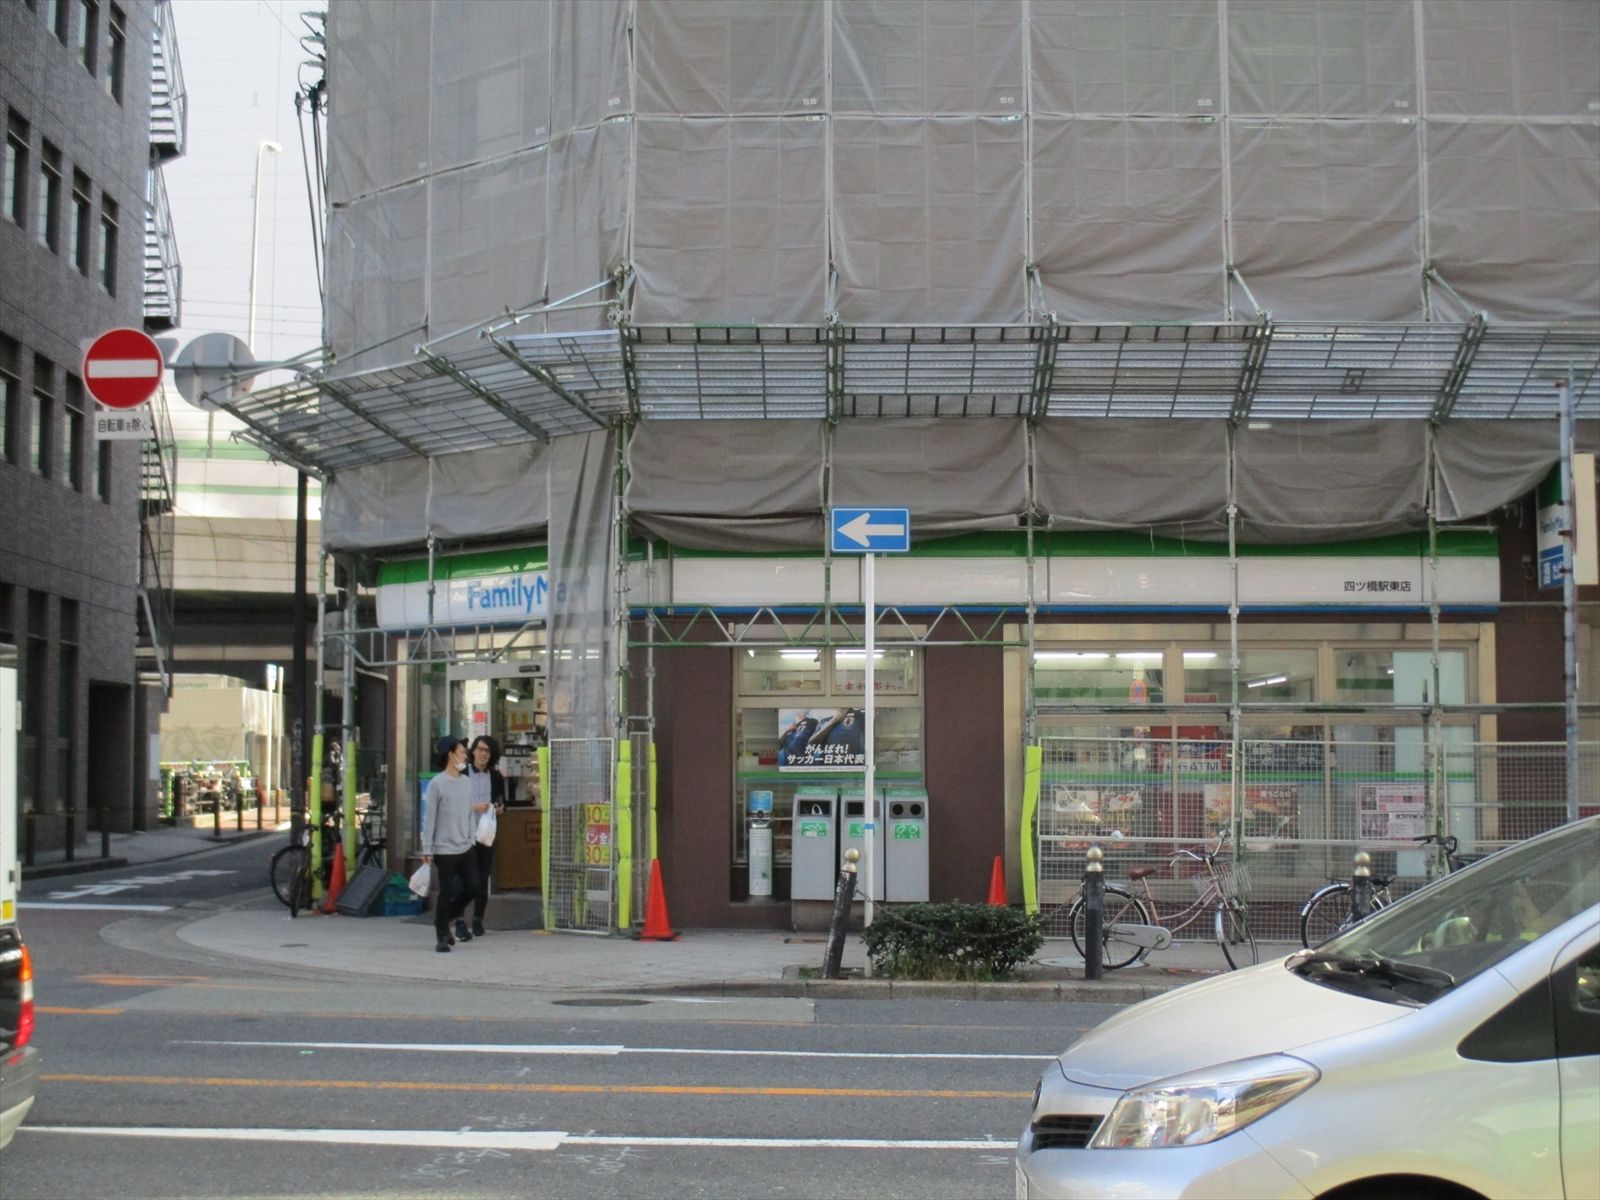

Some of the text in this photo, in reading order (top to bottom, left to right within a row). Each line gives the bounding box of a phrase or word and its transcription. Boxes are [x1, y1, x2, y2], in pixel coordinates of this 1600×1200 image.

[98, 418, 147, 433] 自転車を除く
[1343, 580, 1412, 592] 四ツ橋駅東店
[787, 754, 865, 765] サッカー日本代表
